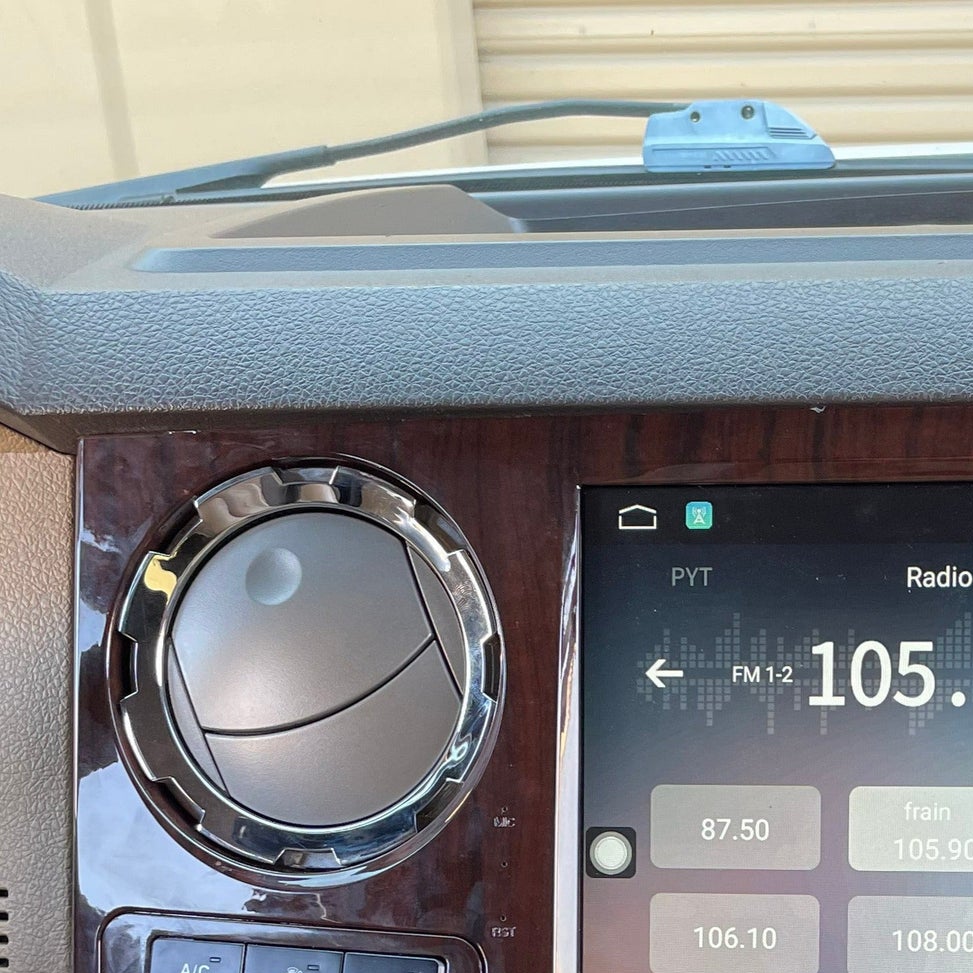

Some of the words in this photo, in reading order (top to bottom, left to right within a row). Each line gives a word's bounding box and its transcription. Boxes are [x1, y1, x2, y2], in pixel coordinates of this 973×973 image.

[671, 568, 712, 587] PYT
[907, 567, 973, 589] Radio
[732, 666, 761, 683] FM
[766, 666, 793, 683] 1-2
[903, 800, 951, 822] frain
[700, 818, 770, 842] 87.50
[693, 926, 777, 951] 106.10
